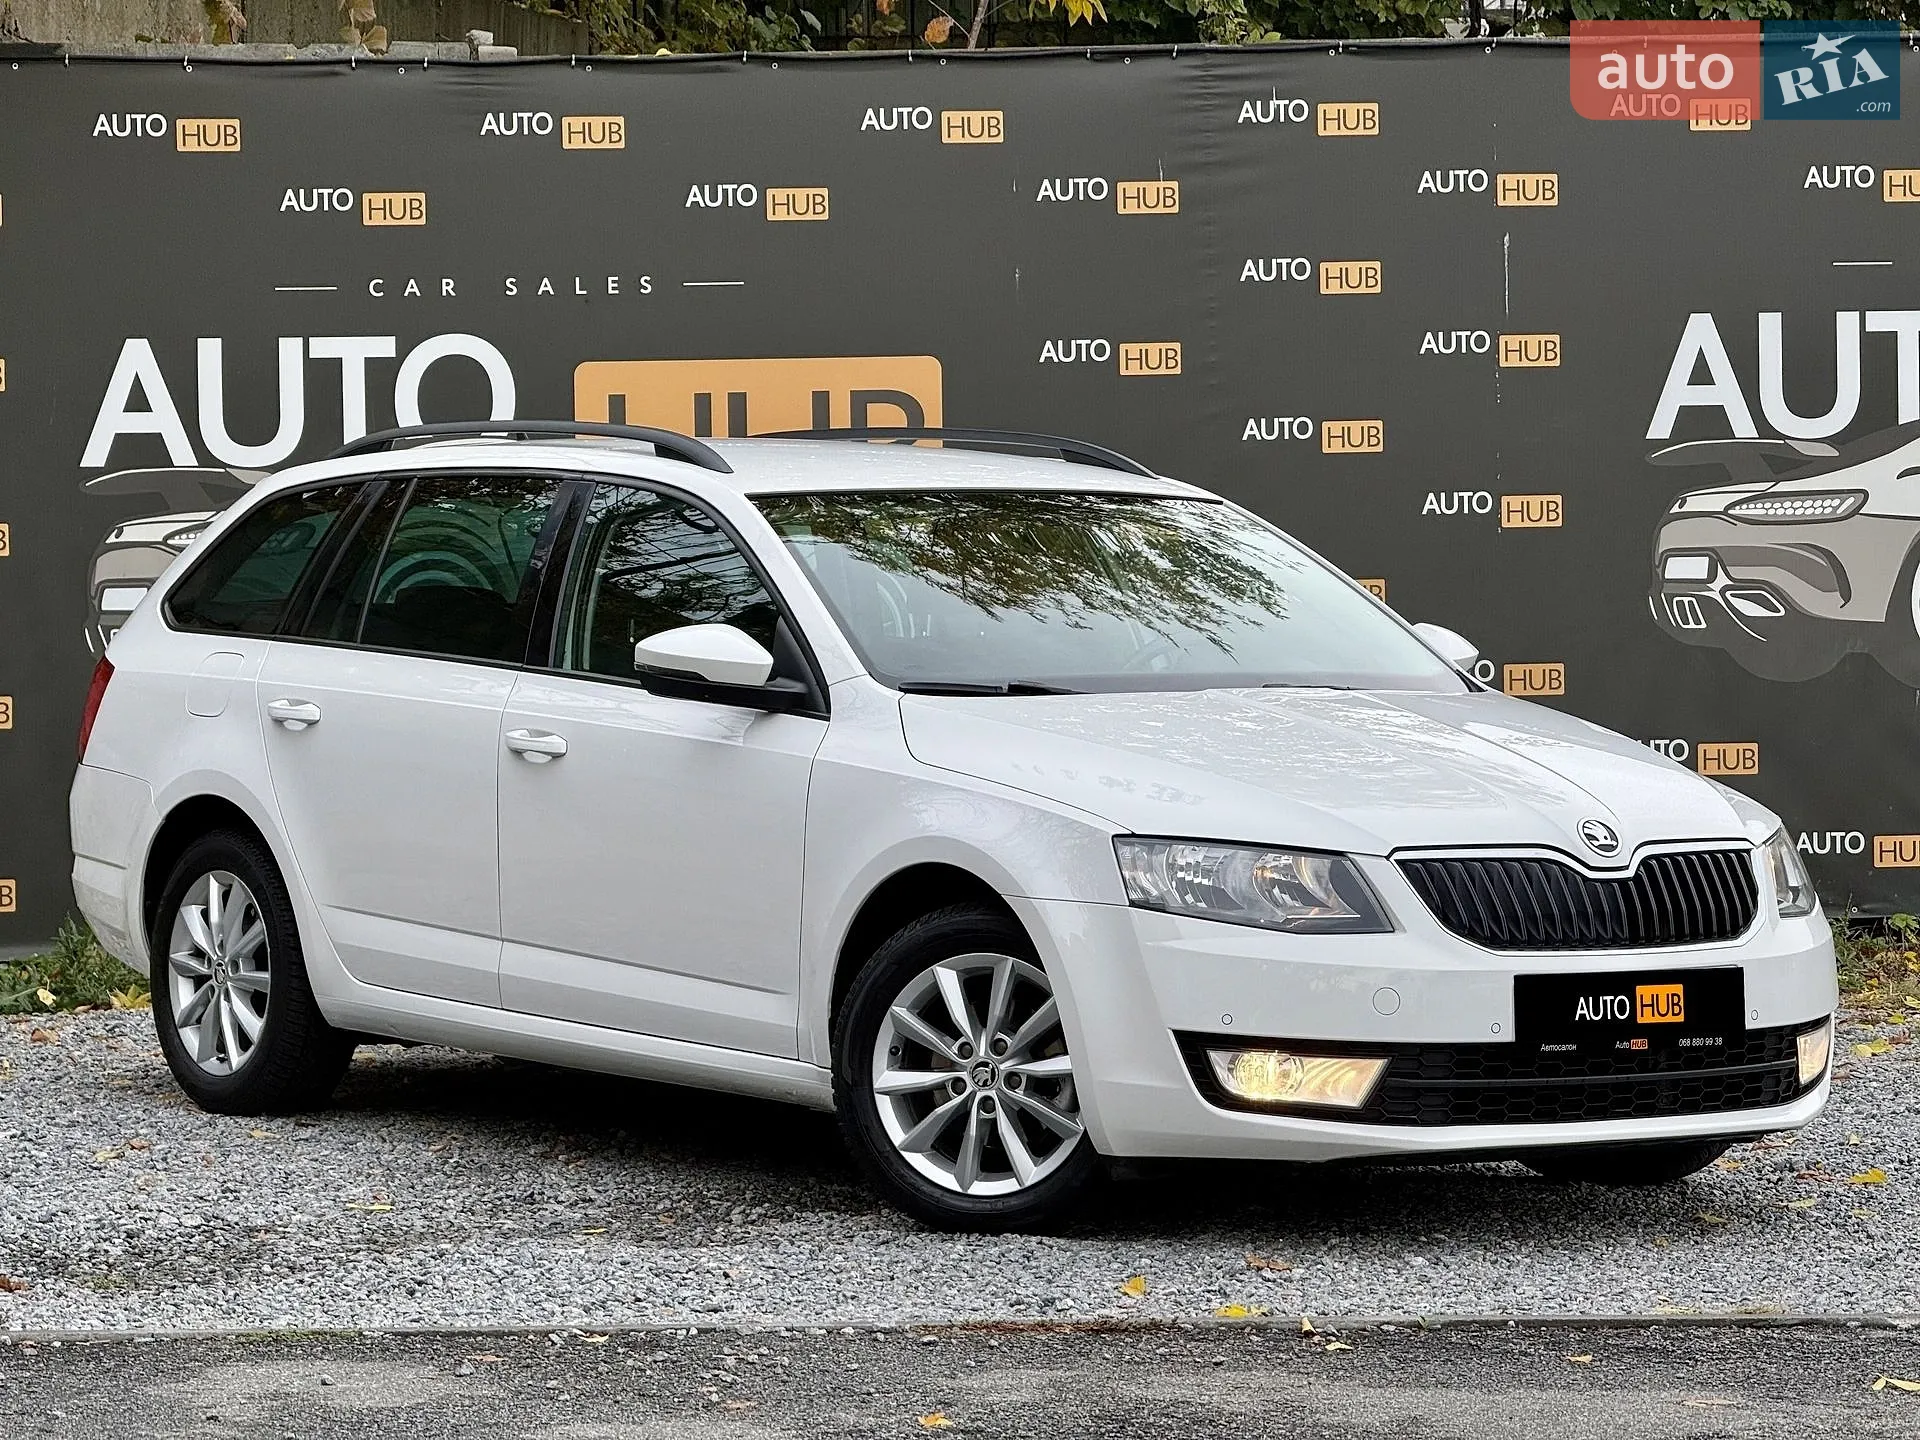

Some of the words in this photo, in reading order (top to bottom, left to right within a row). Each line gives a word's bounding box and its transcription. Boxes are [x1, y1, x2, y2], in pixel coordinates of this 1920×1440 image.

[861, 107, 932, 130] AUTO
[946, 117, 1001, 139] HUB
[1238, 101, 1308, 123] AUTO
[1322, 109, 1377, 131] HUB
[1609, 93, 1681, 117] AUTO
[1694, 104, 1750, 126] HUB
[93, 113, 167, 136] AUTO
[181, 125, 238, 147] HUB
[481, 112, 553, 135] AUTO
[567, 122, 623, 145] HUB
[1037, 178, 1108, 201] AUTO
[1122, 187, 1177, 209] HUB
[1418, 169, 1488, 193] AUTO
[1502, 180, 1556, 202] HUB
[1804, 165, 1875, 188] AUTO
[1889, 175, 1920, 197] HU
[280, 188, 353, 212] AUTO
[368, 199, 424, 221] HUB
[686, 184, 758, 207] AUTO
[771, 194, 827, 216] HUB
[369, 278, 456, 297] CAR
[505, 275, 653, 296] SALES
[1240, 258, 1311, 281] AUTO
[1325, 267, 1379, 289] HUB
[1039, 339, 1110, 362] AUTO
[1124, 348, 1179, 371] HUB
[1420, 331, 1490, 354] AUTO
[1504, 340, 1558, 362] HUB
[1645, 311, 1920, 439] AUT
[80, 333, 516, 467] AUTO
[1242, 417, 1313, 440] AUTO
[1327, 426, 1381, 448] HUB
[1422, 491, 1492, 515] AUTO
[1506, 501, 1560, 523] HUB
[1508, 669, 1563, 691] HUB
[1703, 749, 1756, 770] HUB
[1797, 832, 1865, 854] AUTO
[1879, 841, 1920, 862] HU
[1575, 995, 1630, 1021] AUTO
[1639, 993, 1683, 1018] HUB
[1631, 1040, 1647, 1048] HUB
[1679, 1038, 1691, 1047] 068
[1705, 1037, 1714, 1046] 99
[1715, 1037, 1723, 1046] 38
